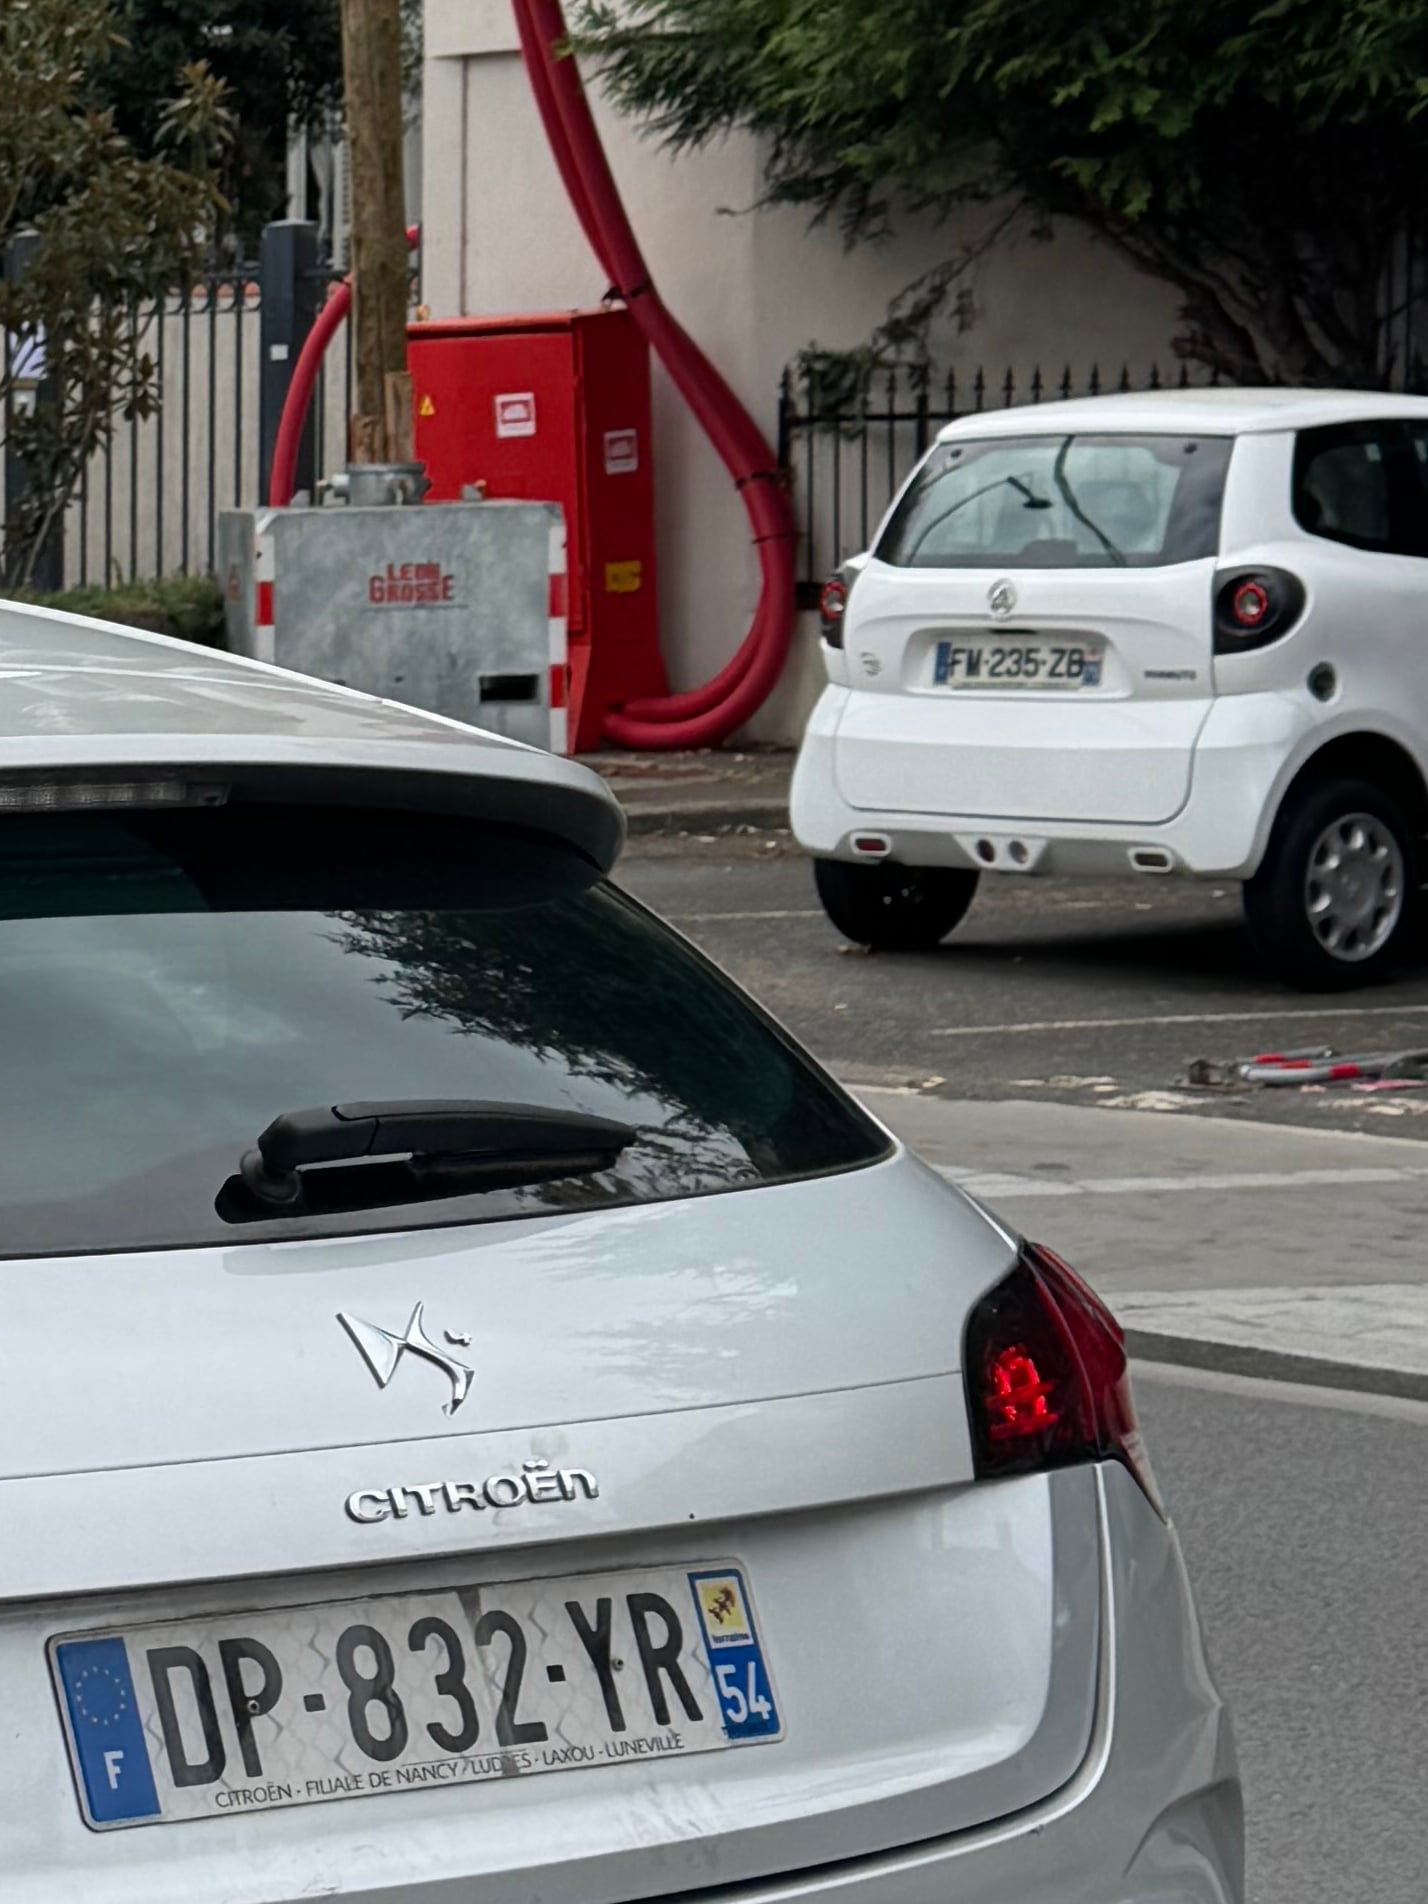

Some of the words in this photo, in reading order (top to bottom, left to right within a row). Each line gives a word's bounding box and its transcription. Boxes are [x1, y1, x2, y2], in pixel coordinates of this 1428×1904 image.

[146, 1592, 704, 1788] DP-832-YR
[715, 1661, 772, 1724] 54
[104, 1750, 124, 1790] F
[215, 1781, 293, 1808] CITROËN
[306, 1773, 362, 1795] FILIALE
[369, 1770, 393, 1787] DE
[396, 1762, 458, 1784] NANCY
[471, 1752, 532, 1774] LUDES
[543, 1746, 595, 1766] LAXOU
[607, 1734, 685, 1758] LUNEVILLE
